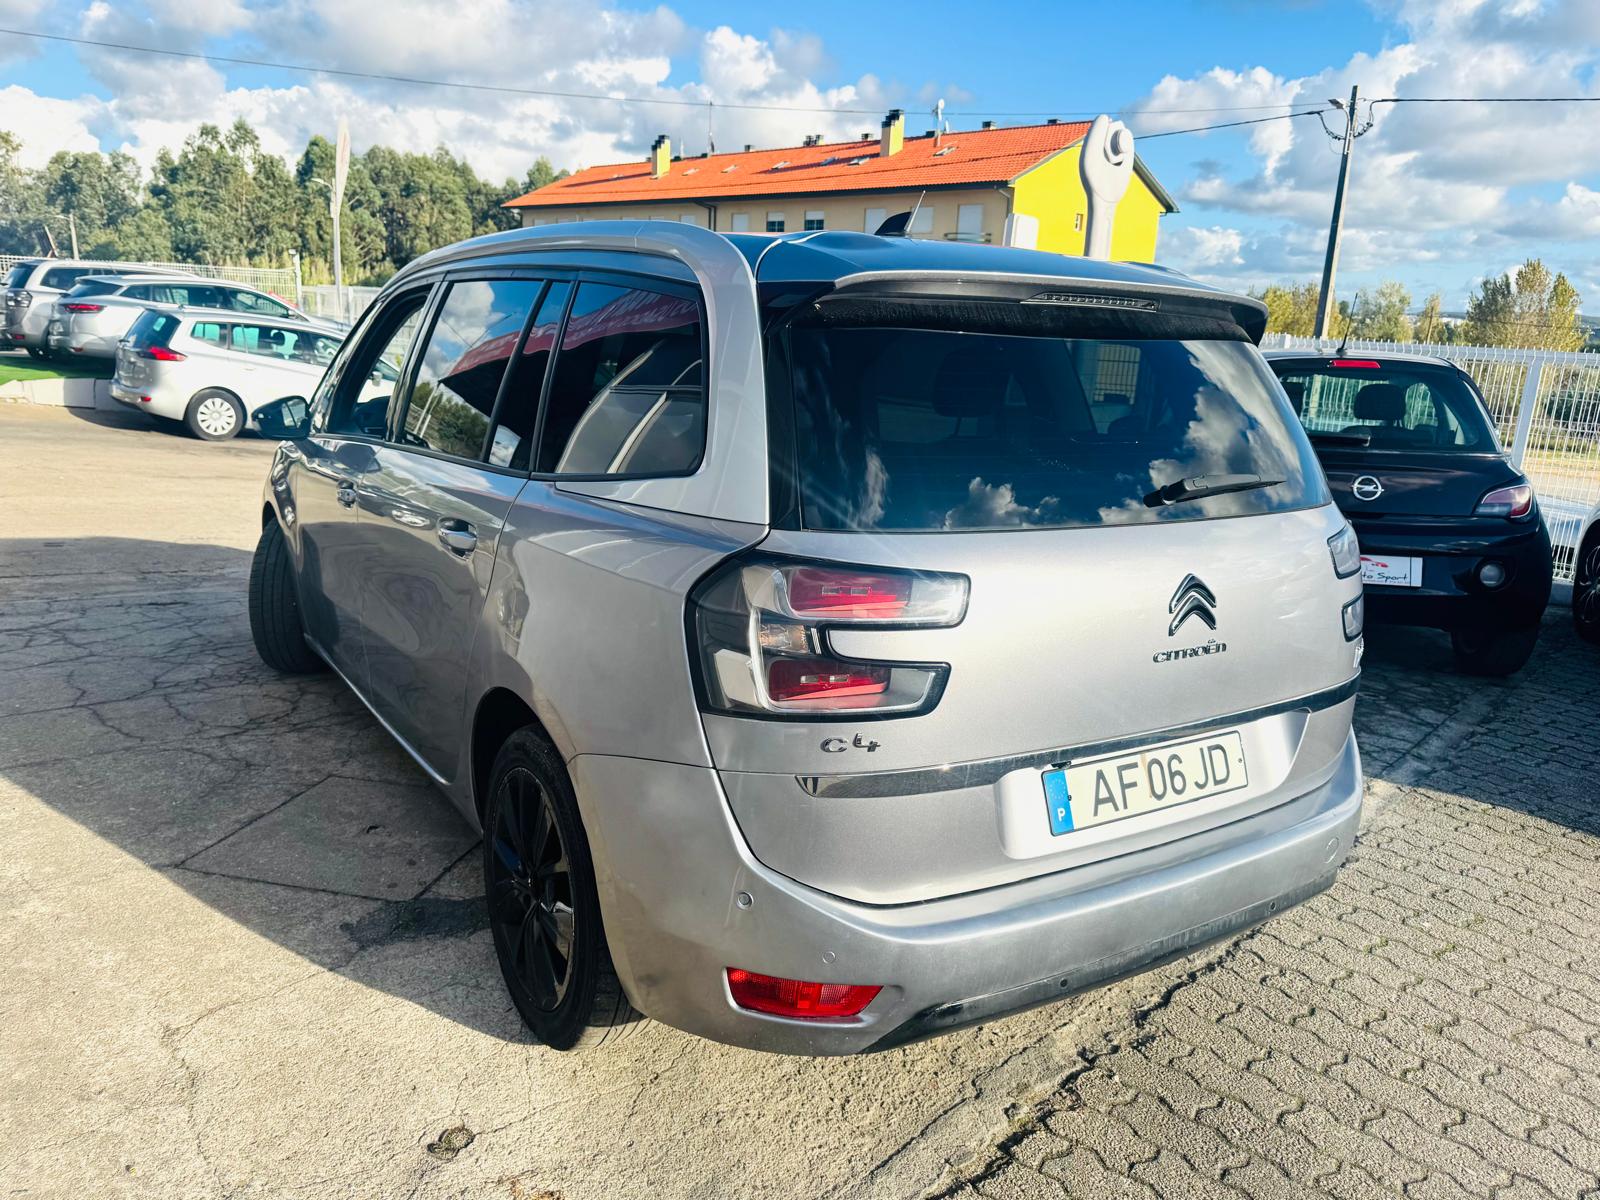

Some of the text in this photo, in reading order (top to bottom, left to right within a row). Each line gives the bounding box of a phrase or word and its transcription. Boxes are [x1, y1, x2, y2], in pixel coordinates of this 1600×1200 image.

[1377, 572, 1409, 584] Sport
[820, 732, 881, 753] C4
[1093, 743, 1231, 817] AF 06 JD
[1057, 807, 1066, 822] P
